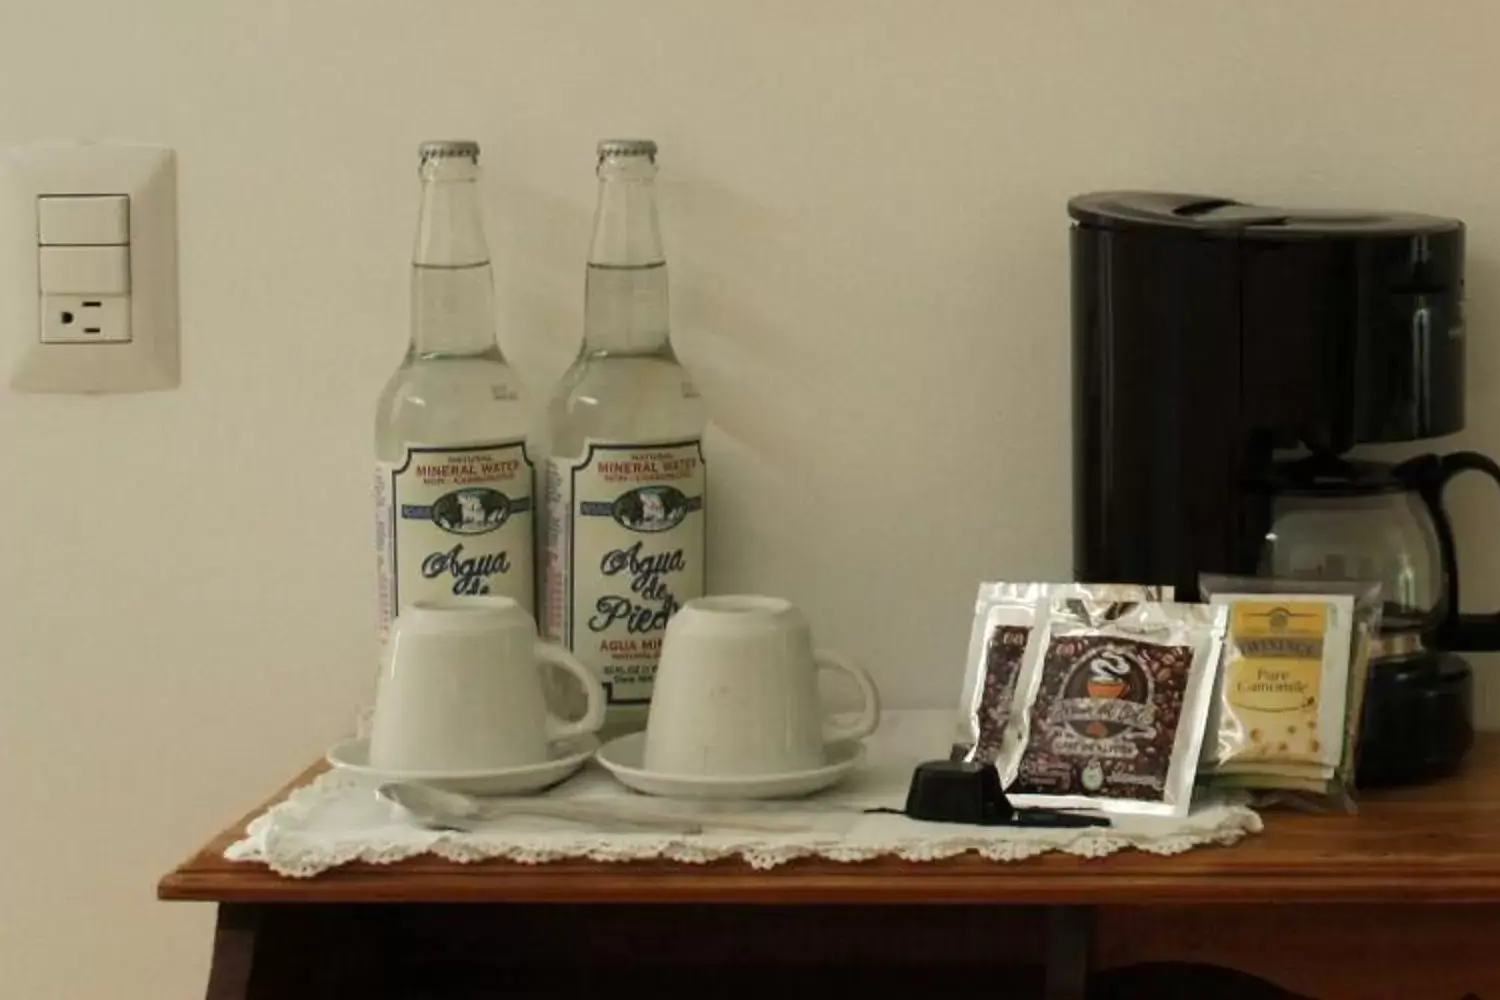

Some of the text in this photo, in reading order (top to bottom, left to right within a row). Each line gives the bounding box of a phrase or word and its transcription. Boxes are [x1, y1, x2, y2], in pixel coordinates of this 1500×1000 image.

[416, 459, 519, 477] MINERAL WATER
[598, 461, 658, 474] MINERAL
[421, 542, 511, 595] Agua
[600, 540, 686, 593] Agua
[642, 576, 668, 601] de
[588, 595, 680, 634] Pied
[601, 639, 637, 652] AGUA
[1258, 669, 1290, 681] Pure
[1237, 681, 1308, 694] Camomile
